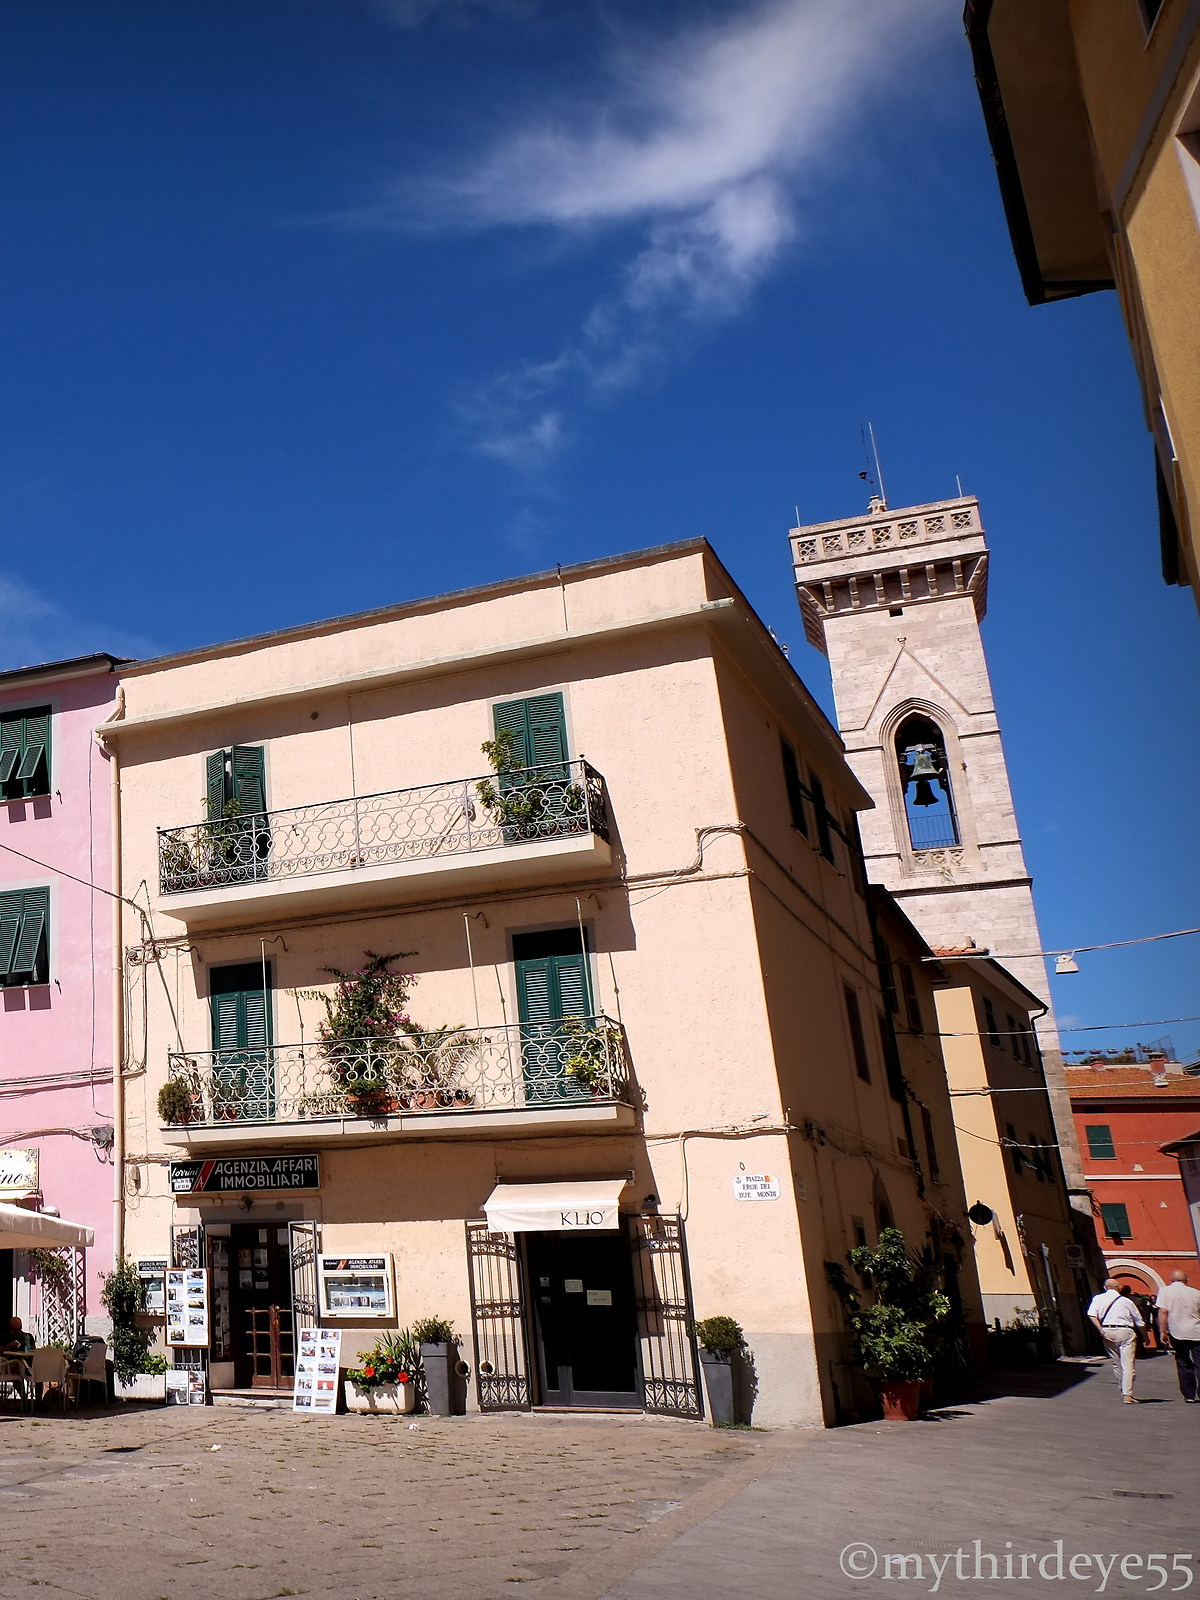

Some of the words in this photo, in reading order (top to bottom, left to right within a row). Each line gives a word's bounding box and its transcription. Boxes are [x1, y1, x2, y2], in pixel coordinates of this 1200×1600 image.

[214, 1161, 270, 1175] AGENZIA
[271, 1158, 317, 1172] AFFARI
[220, 1173, 305, 1189] IMMOBILIARI
